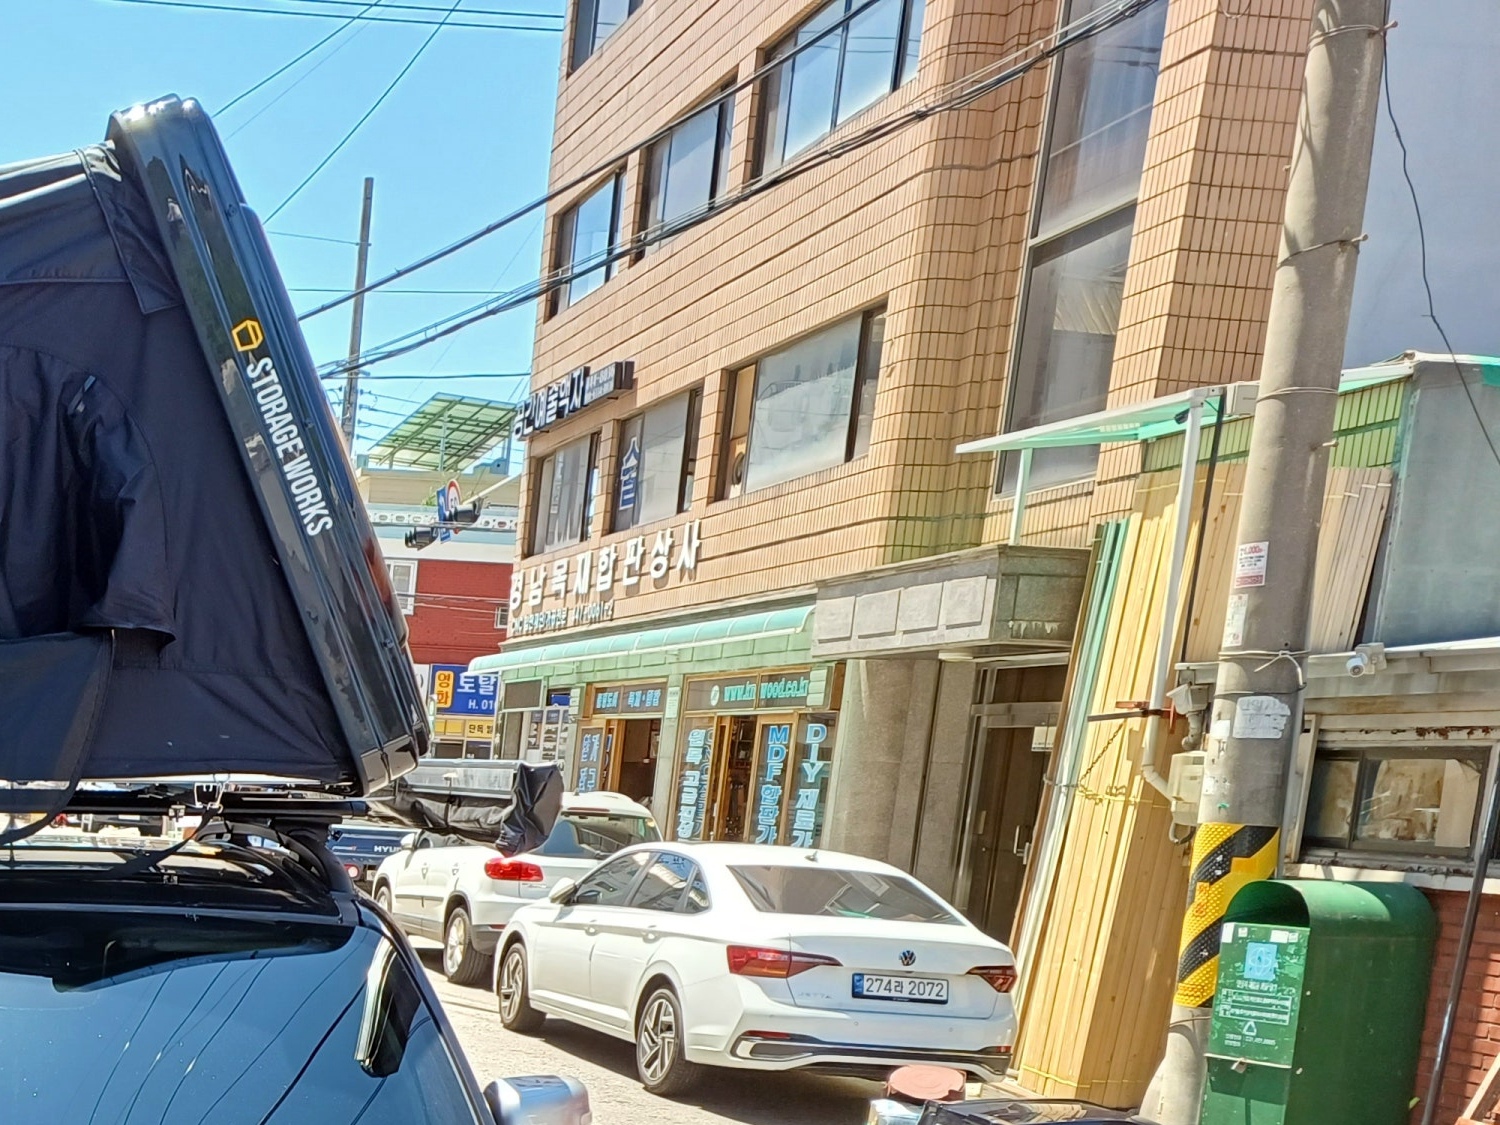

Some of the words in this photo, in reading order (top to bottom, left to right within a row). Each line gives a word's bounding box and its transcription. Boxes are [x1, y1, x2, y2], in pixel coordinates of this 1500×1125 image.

[246, 356, 305, 460] STORAGE
[283, 453, 334, 537] WORKS
[437, 672, 451, 706] 영화
[481, 699, 497, 710] 01
[766, 725, 790, 782] MDF
[802, 723, 827, 783] DIY
[865, 977, 904, 994] 274라
[908, 980, 945, 998] 2072
